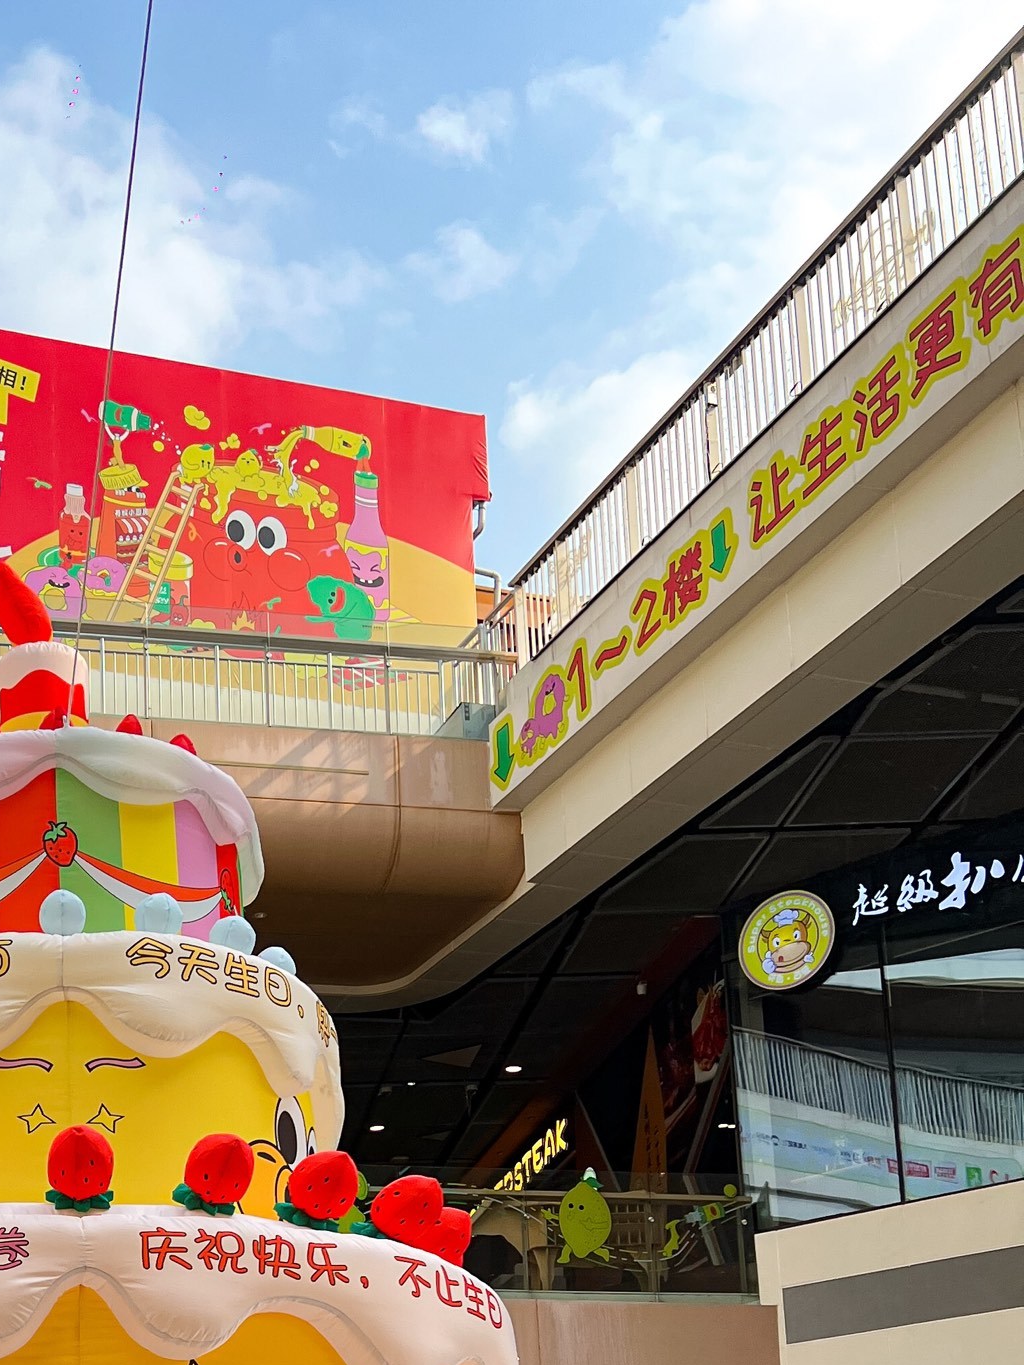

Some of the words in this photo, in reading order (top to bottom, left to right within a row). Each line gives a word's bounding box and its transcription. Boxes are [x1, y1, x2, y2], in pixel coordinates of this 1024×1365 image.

[749, 237, 1024, 542] 让生活更有
[852, 851, 1024, 926] 超級扒
